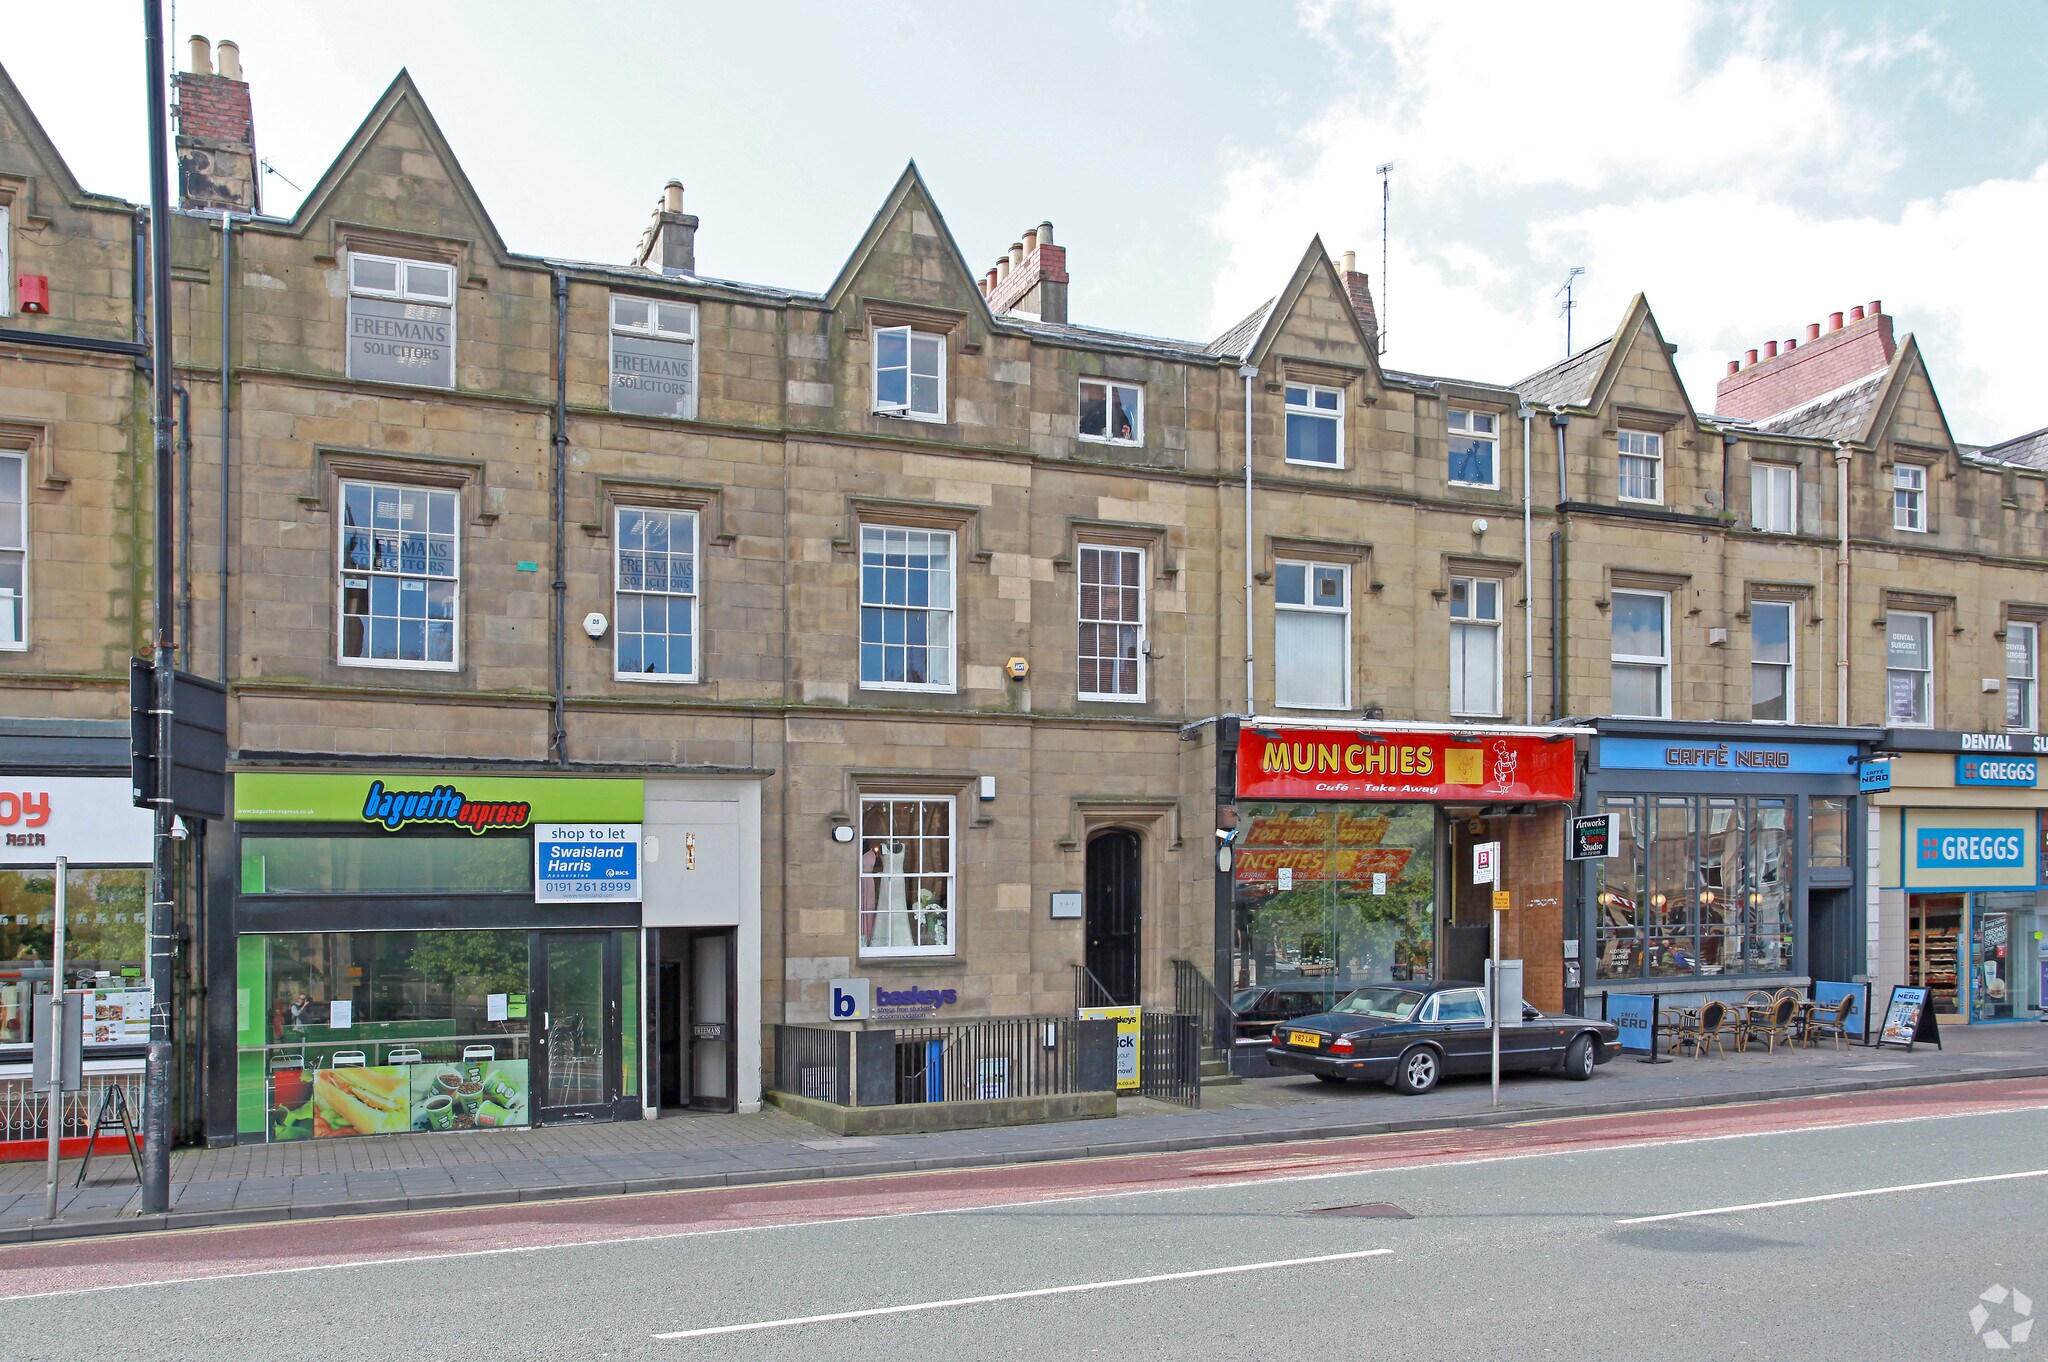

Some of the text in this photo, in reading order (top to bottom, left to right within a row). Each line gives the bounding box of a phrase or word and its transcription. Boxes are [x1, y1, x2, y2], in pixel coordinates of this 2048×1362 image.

[354, 317, 446, 342] FREEMANS
[363, 341, 440, 361] SOLICITORS
[614, 354, 689, 378] FREEMANS
[618, 376, 686, 396] SOLICITORS
[351, 553, 446, 573] SOICITORS
[620, 557, 694, 577] FREEMANS
[1892, 633, 1914, 642] DENTAL
[1890, 641, 1916, 650] SURGERY
[2007, 651, 2028, 660] URGERY
[1961, 733, 2012, 751] DENTAL
[1263, 743, 1435, 776] MUNCHIES
[1666, 744, 1790, 768] CAFFÈ NERO
[1861, 774, 1889, 783] NERO
[1979, 762, 2035, 781] GREGGS
[1315, 783, 1349, 792] Café
[1364, 784, 1396, 793] Take
[1399, 785, 1439, 795] Away
[237, 808, 315, 816] www.baguette-express.co.uk
[365, 784, 529, 830] baguette express
[1576, 818, 1606, 829] Artworks
[6, 833, 46, 847] ASIA
[551, 827, 626, 842] shop to let
[1580, 835, 1587, 844] &
[550, 845, 625, 858] Swaisland
[1582, 842, 1603, 852] Studio
[1942, 836, 2019, 860] GREGGS
[547, 860, 592, 872] Harris
[546, 882, 632, 892] 0191 261 8999
[876, 986, 957, 1009] baskeys
[694, 1026, 720, 1035] FREEMANS
[1611, 1018, 1648, 1029] NERO
